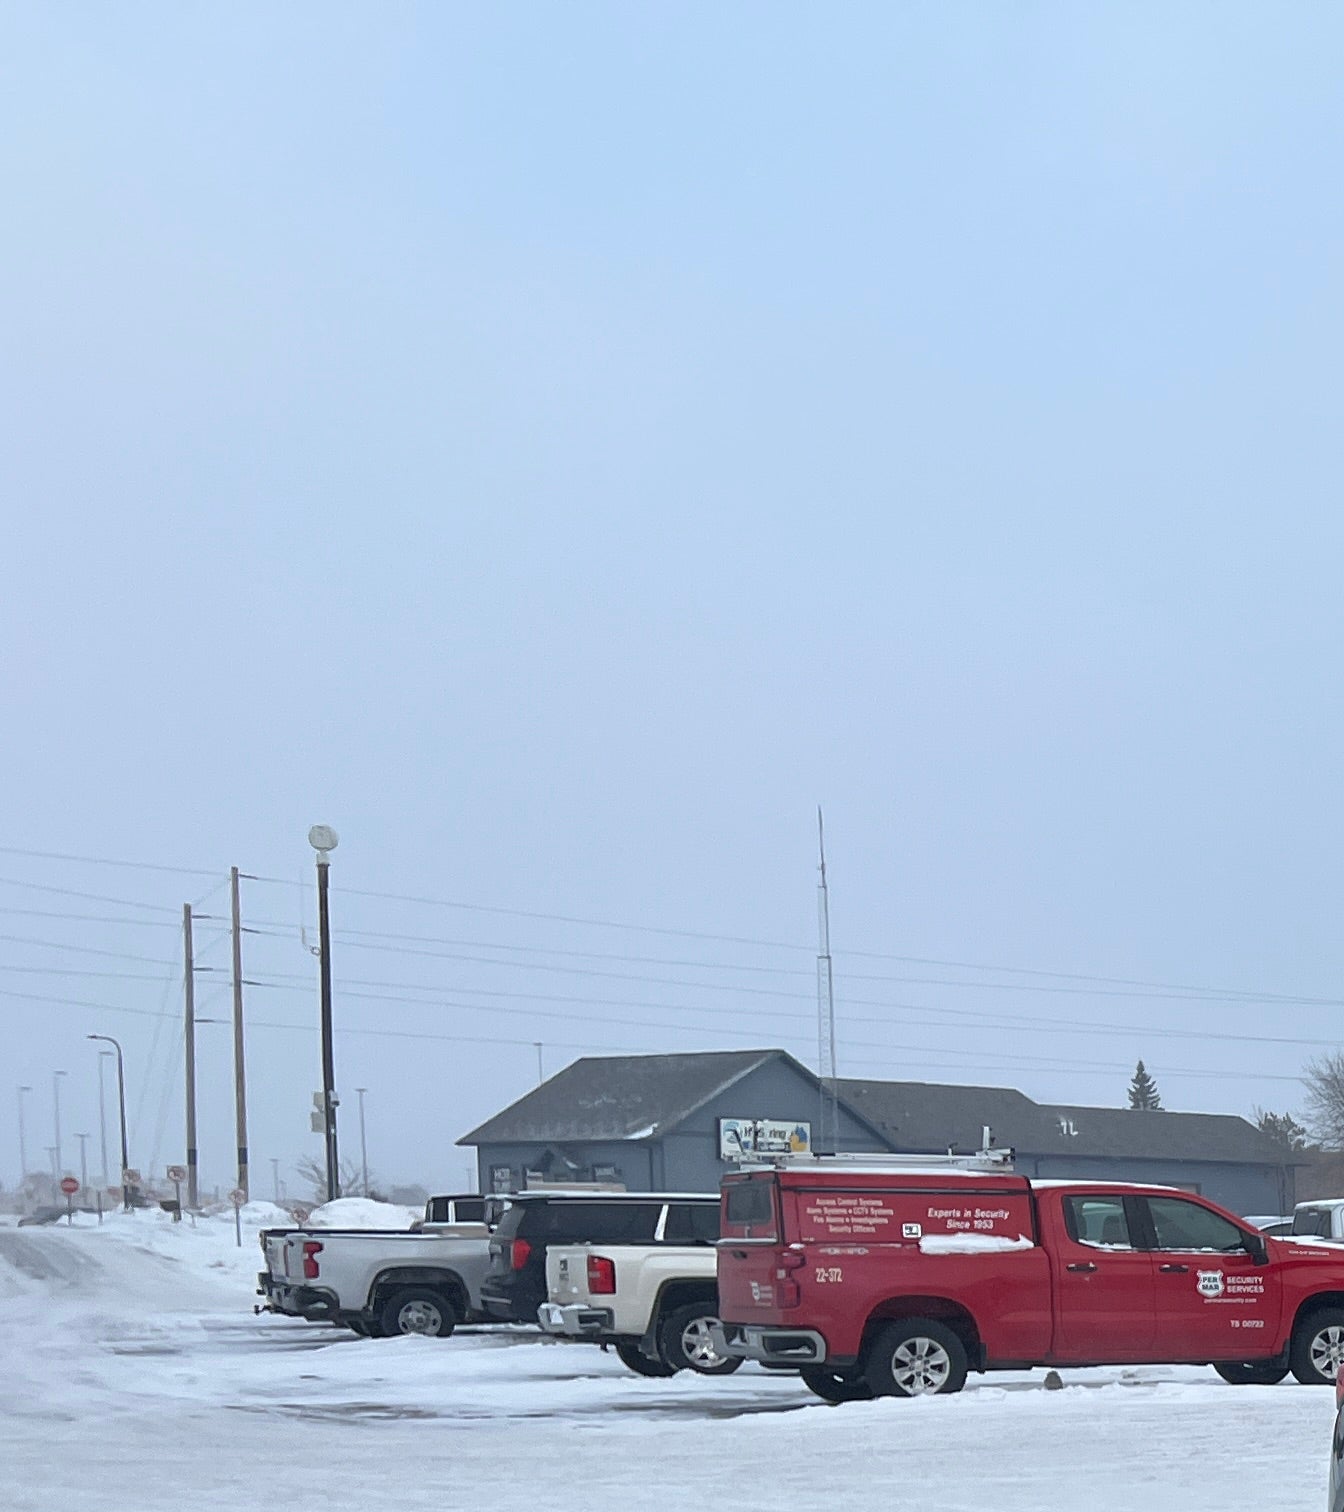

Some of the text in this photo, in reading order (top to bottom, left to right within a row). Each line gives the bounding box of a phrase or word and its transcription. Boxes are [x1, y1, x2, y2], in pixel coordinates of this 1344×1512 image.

[927, 1208, 1010, 1220] Experts in Security
[946, 1219, 971, 1229] Since
[815, 1268, 843, 1282] 22-372
[1226, 1276, 1264, 1284] SECURITY
[1226, 1285, 1265, 1293] SERVICES
